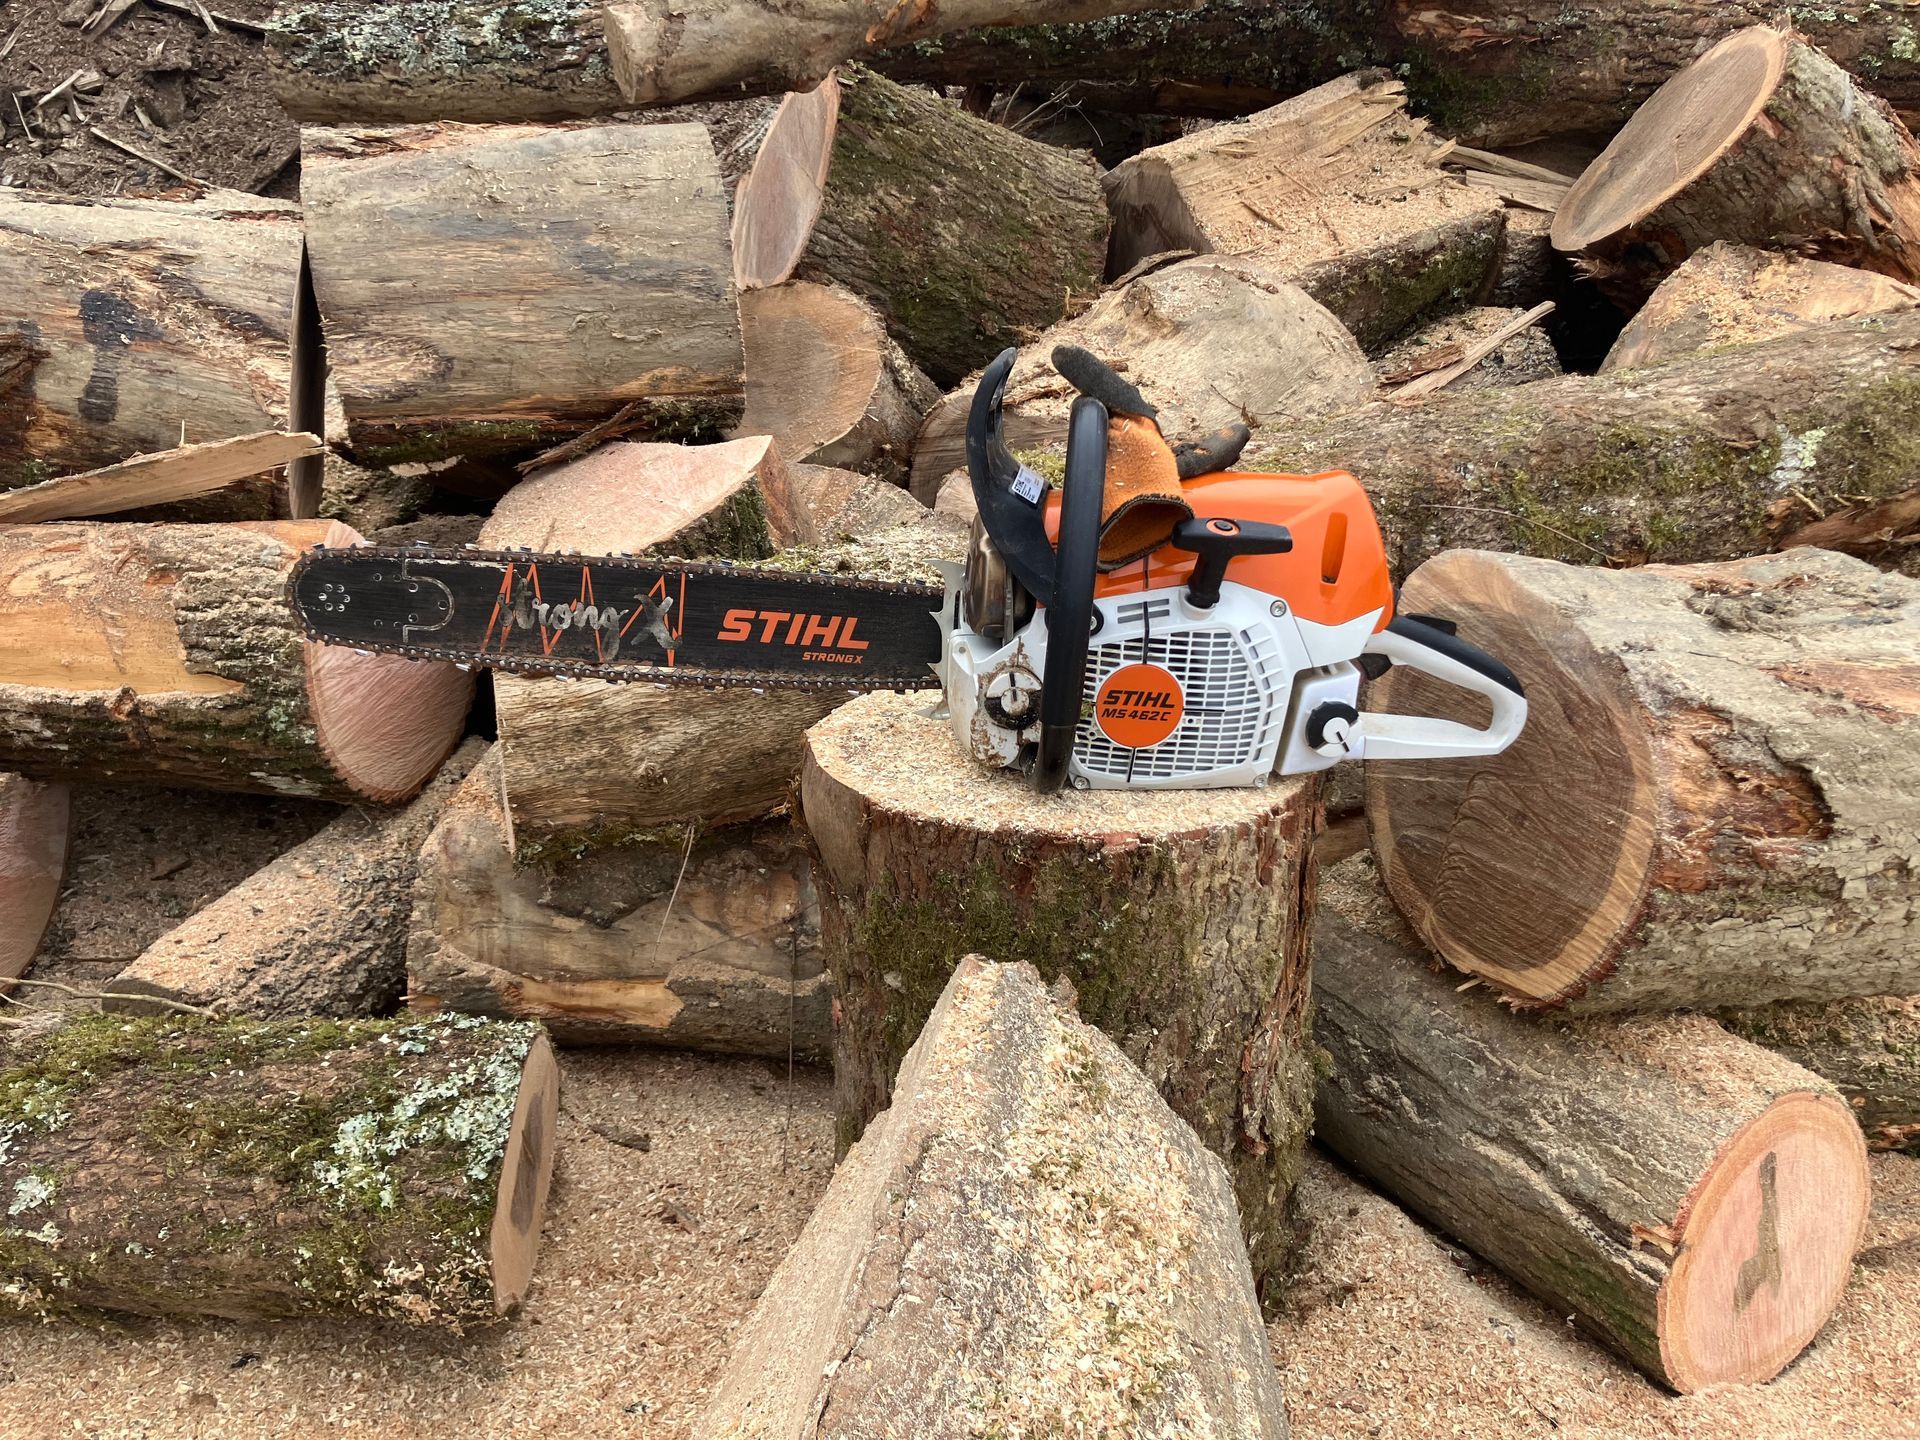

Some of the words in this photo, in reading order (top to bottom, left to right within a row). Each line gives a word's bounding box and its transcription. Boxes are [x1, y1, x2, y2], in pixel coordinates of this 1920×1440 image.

[631, 594, 683, 649] X
[717, 609, 869, 649] STIHL
[1101, 708, 1127, 718] MS
[1103, 690, 1174, 708] STIHL
